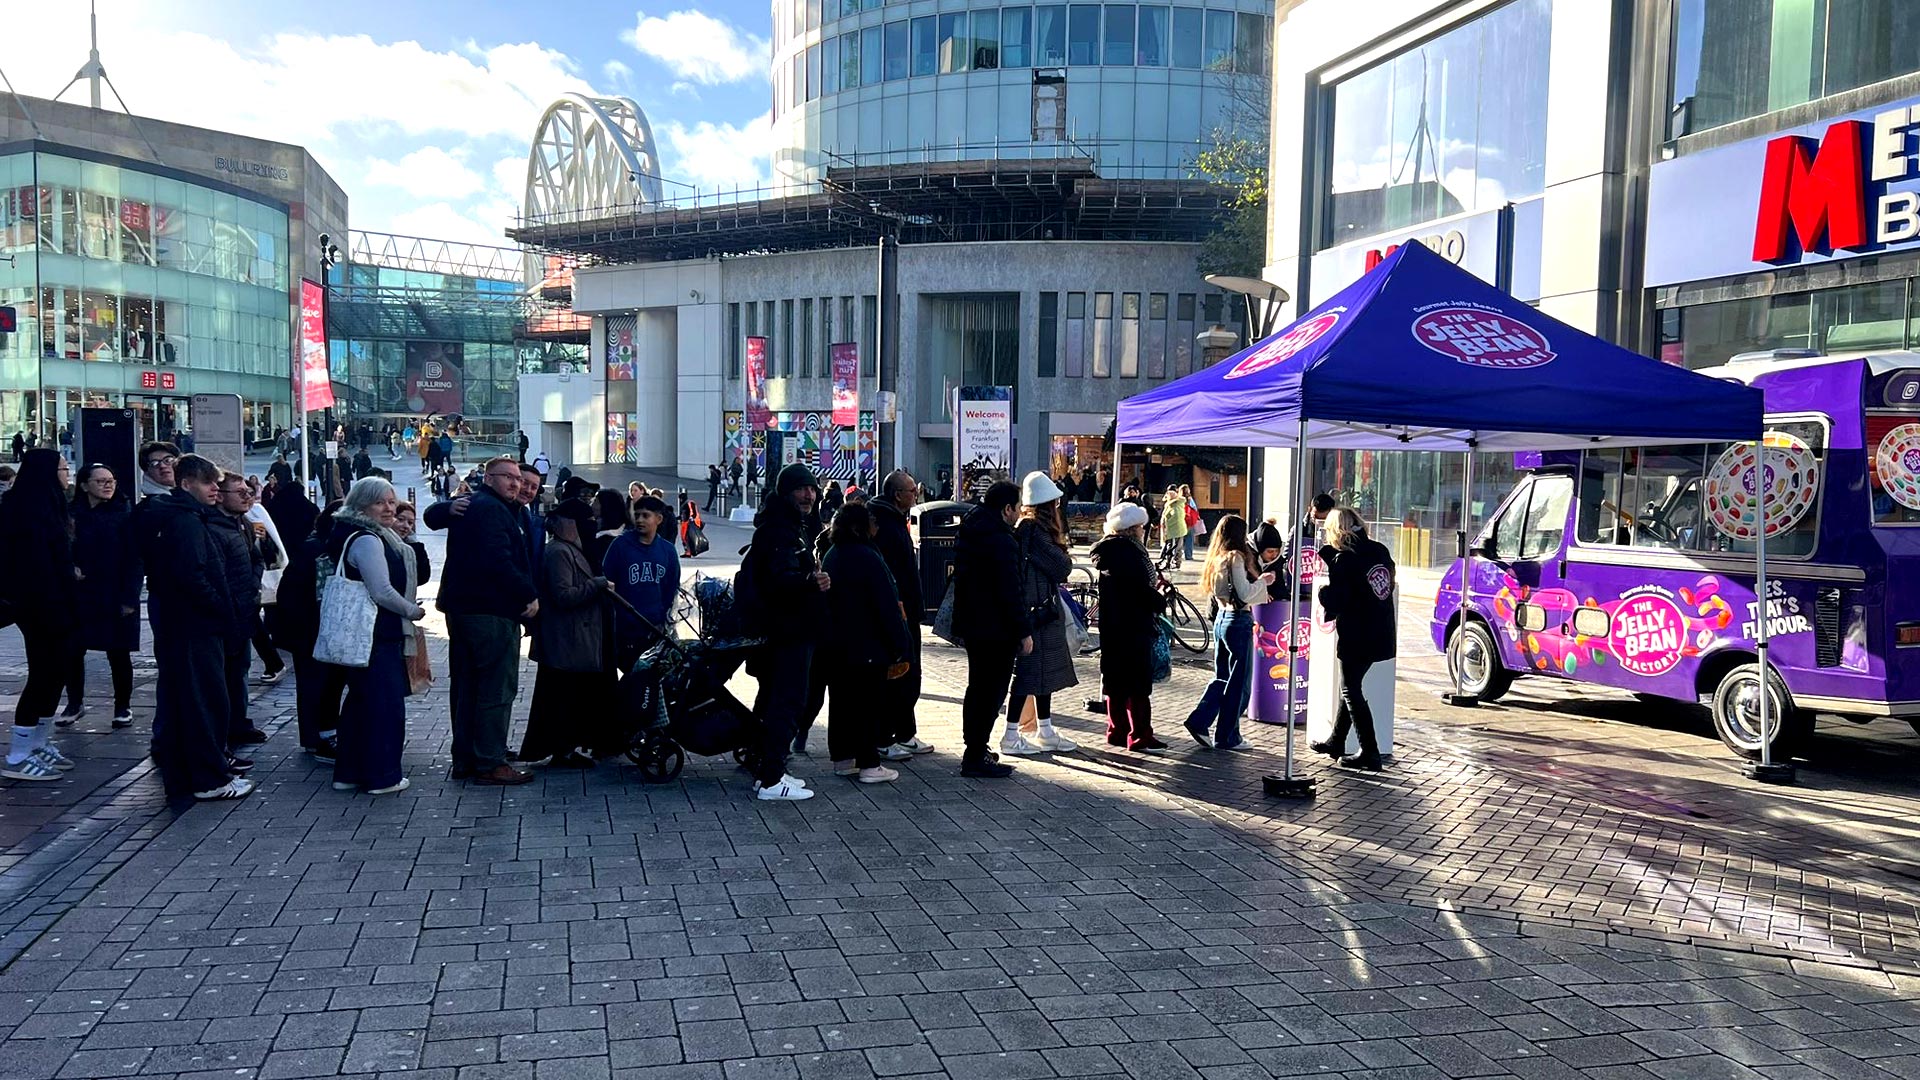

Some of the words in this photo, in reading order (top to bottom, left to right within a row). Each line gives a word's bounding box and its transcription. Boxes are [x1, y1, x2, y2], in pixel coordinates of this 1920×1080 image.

[215, 156, 288, 181] BULLRING
[1877, 191, 1920, 243] B
[1450, 300, 1472, 308] Jelly
[1441, 313, 1476, 323] THE
[1421, 319, 1507, 342] JELLY
[1450, 333, 1541, 356] BEAN
[1464, 350, 1549, 366] FACTORY
[416, 380, 453, 388] BULLRING
[965, 410, 1005, 418] Welcome
[628, 562, 666, 584] GAP
[1754, 580, 1787, 598] ES.
[1632, 601, 1652, 613] THE
[1746, 596, 1800, 620] TAT'S
[1615, 608, 1666, 638] JELLY
[1742, 615, 1813, 640] FLVOUR.
[1625, 627, 1677, 657] BEAN
[1625, 651, 1675, 672] FACTORY
